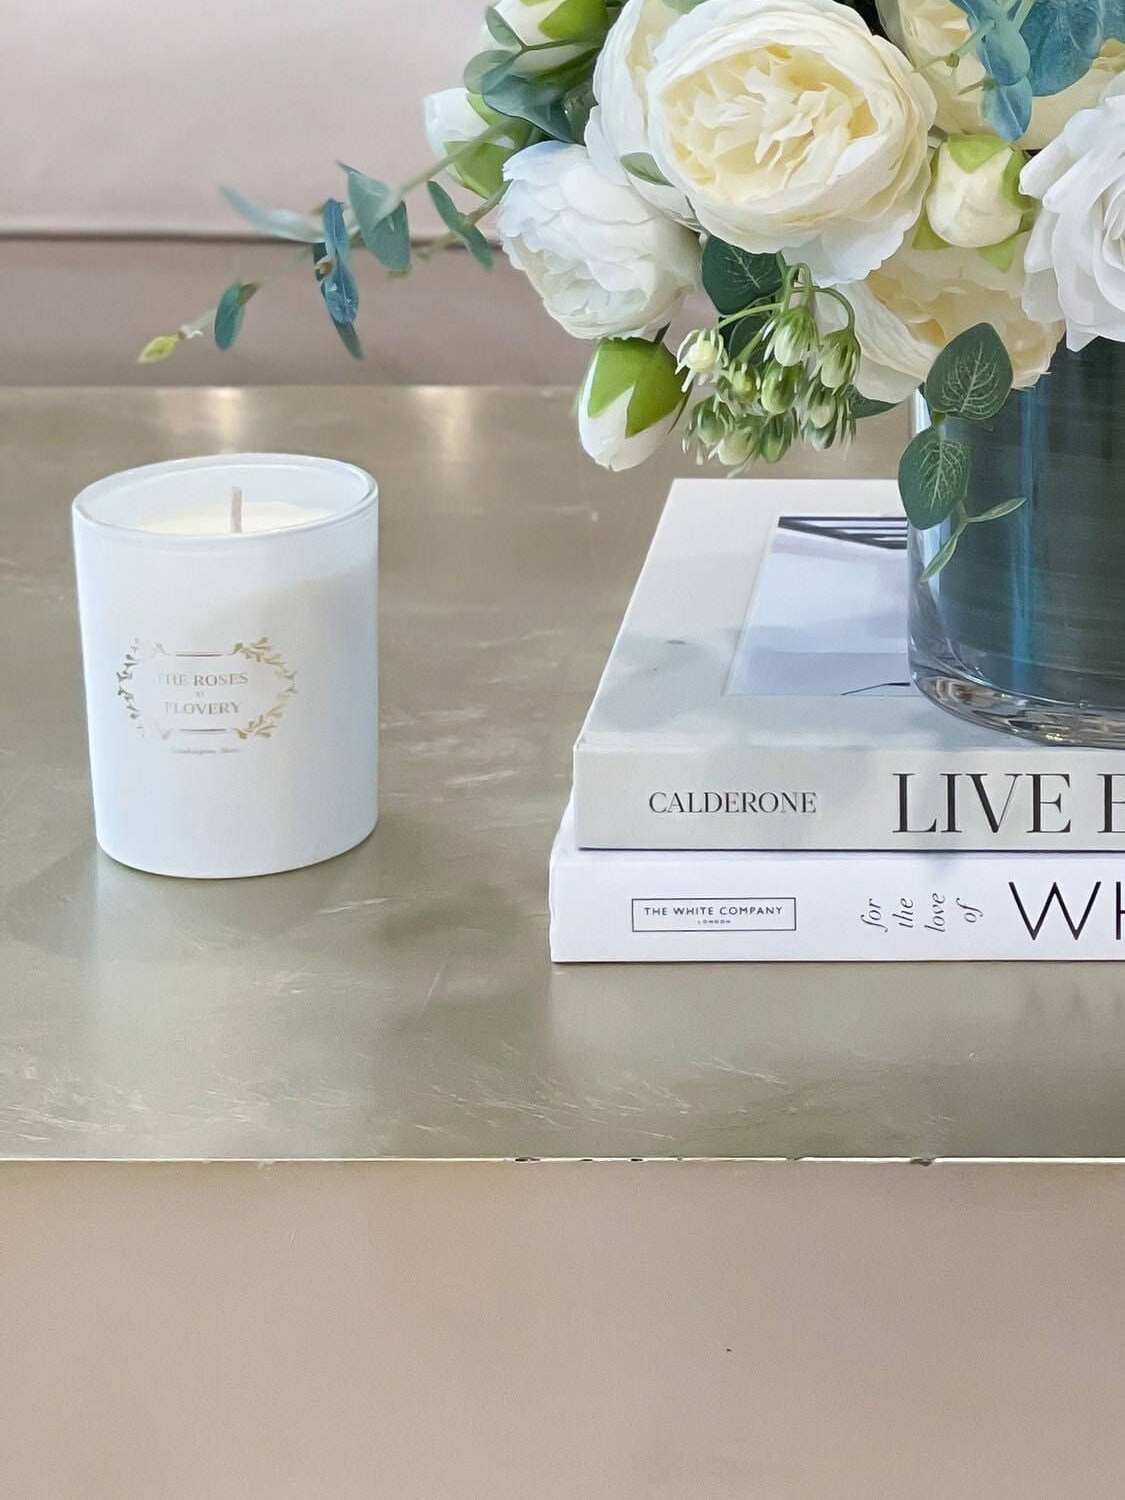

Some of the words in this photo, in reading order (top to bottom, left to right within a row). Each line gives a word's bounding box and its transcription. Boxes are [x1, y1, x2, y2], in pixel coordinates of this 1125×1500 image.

[193, 672, 249, 686] ROSES
[648, 791, 817, 814] CALDERONE
[892, 773, 1071, 834] LIVE
[644, 907, 667, 916] THE
[673, 907, 714, 916] WHITE
[719, 907, 783, 916] COMPANY
[860, 898, 888, 933] for
[892, 897, 915, 930] the
[924, 892, 946, 933] love
[956, 897, 984, 924] of
